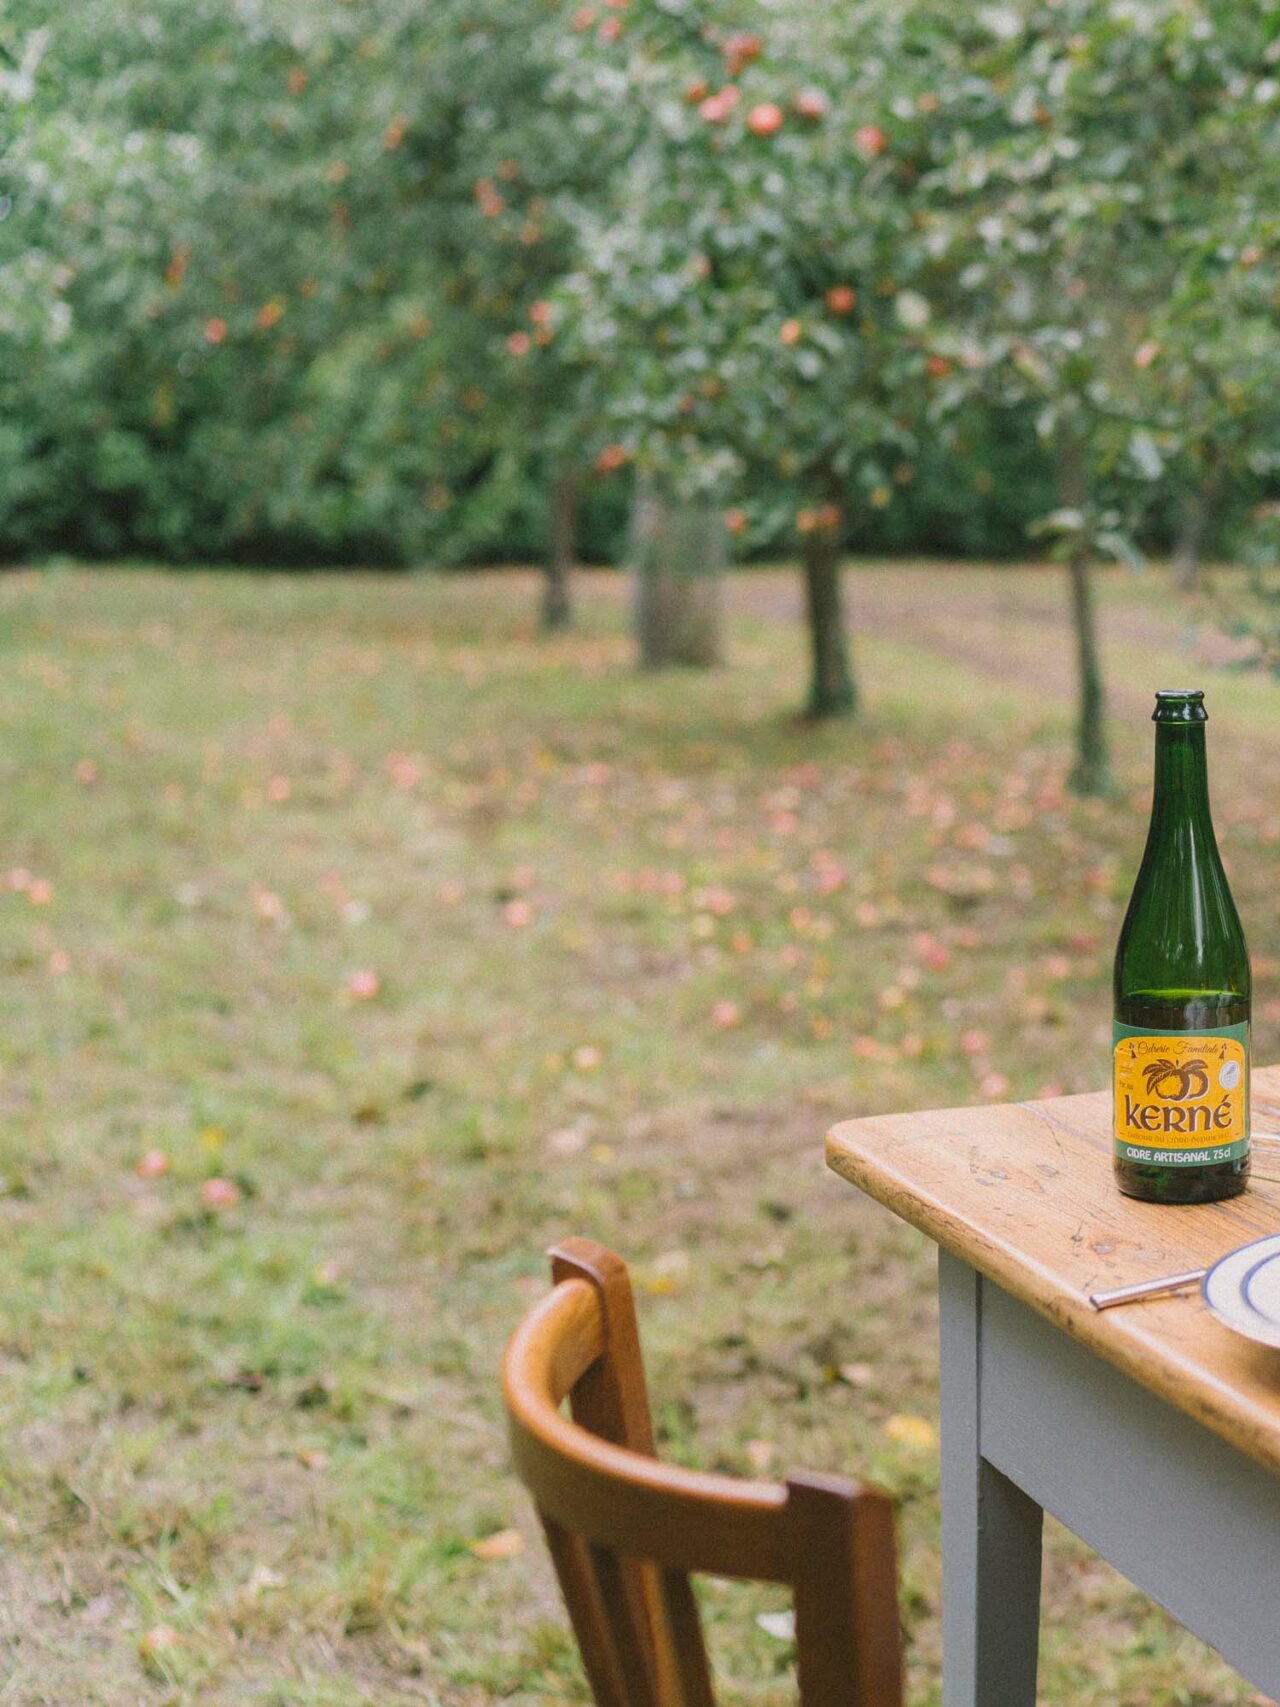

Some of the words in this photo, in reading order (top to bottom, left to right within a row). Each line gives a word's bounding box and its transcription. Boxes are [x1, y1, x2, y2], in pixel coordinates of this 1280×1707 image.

[1173, 1041, 1218, 1054] Familiale
[1127, 1147, 1151, 1160] CIDRE
[1154, 1151, 1210, 1162] ARTISANAL
[1213, 1147, 1231, 1159] 75cl
